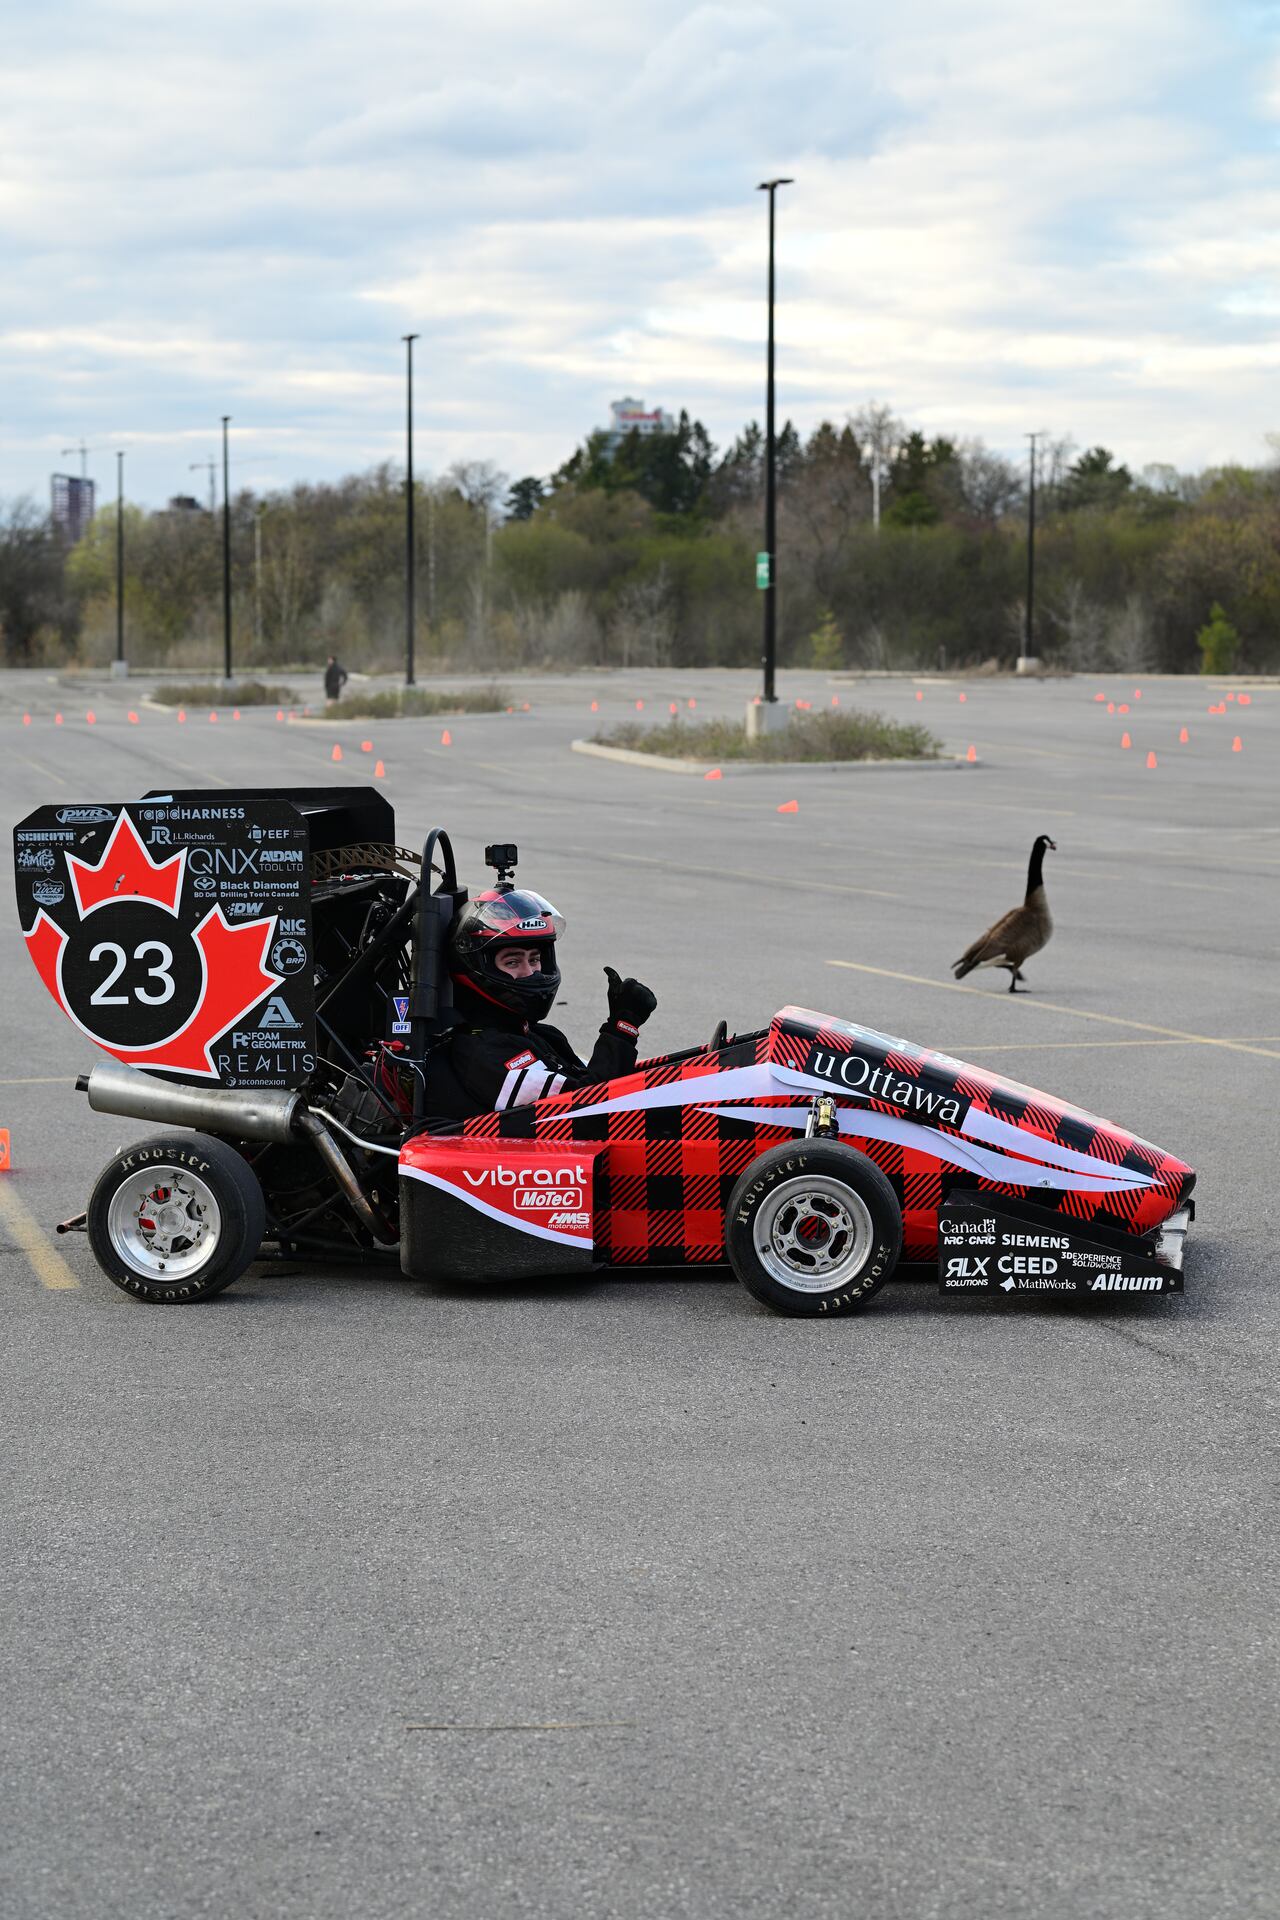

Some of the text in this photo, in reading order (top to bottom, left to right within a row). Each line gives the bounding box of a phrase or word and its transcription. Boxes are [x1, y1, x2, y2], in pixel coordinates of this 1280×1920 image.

[61, 809, 102, 824] PWR
[139, 806, 246, 823] rapidHARNESS
[17, 832, 75, 842] SCHROTH
[268, 829, 290, 839] EEF
[187, 848, 260, 875] QNX
[259, 863, 304, 872] TOOL LTD
[36, 886, 62, 894] LUCAS
[220, 880, 300, 890] Black Diamond
[220, 891, 247, 899] Drilling
[234, 902, 264, 914] DW
[279, 919, 307, 932] NIC
[522, 920, 545, 929] HJC
[286, 957, 305, 965] BRP
[89, 941, 176, 1006] 23
[251, 1032, 280, 1041] FOAM
[251, 1041, 307, 1049] GEOMETRIX
[218, 1054, 315, 1073] REALIS
[813, 1051, 961, 1125] uOttawa
[120, 1148, 211, 1173] Hoosier
[462, 1165, 588, 1187] vibrant
[736, 1154, 808, 1226] Hoosier
[521, 1191, 576, 1207] MoTeC
[548, 1212, 590, 1224] HMS
[939, 1218, 996, 1234] Canada
[1001, 1233, 1070, 1250] SIEMENS
[1060, 1251, 1122, 1264] 3DEXPERIENCE
[997, 1255, 1059, 1275] CEED
[1072, 1260, 1122, 1271] SOLIDWORKS
[945, 1279, 989, 1288] SOLUTIONS
[1018, 1278, 1077, 1290] MathWorks
[1091, 1273, 1163, 1291] Altium
